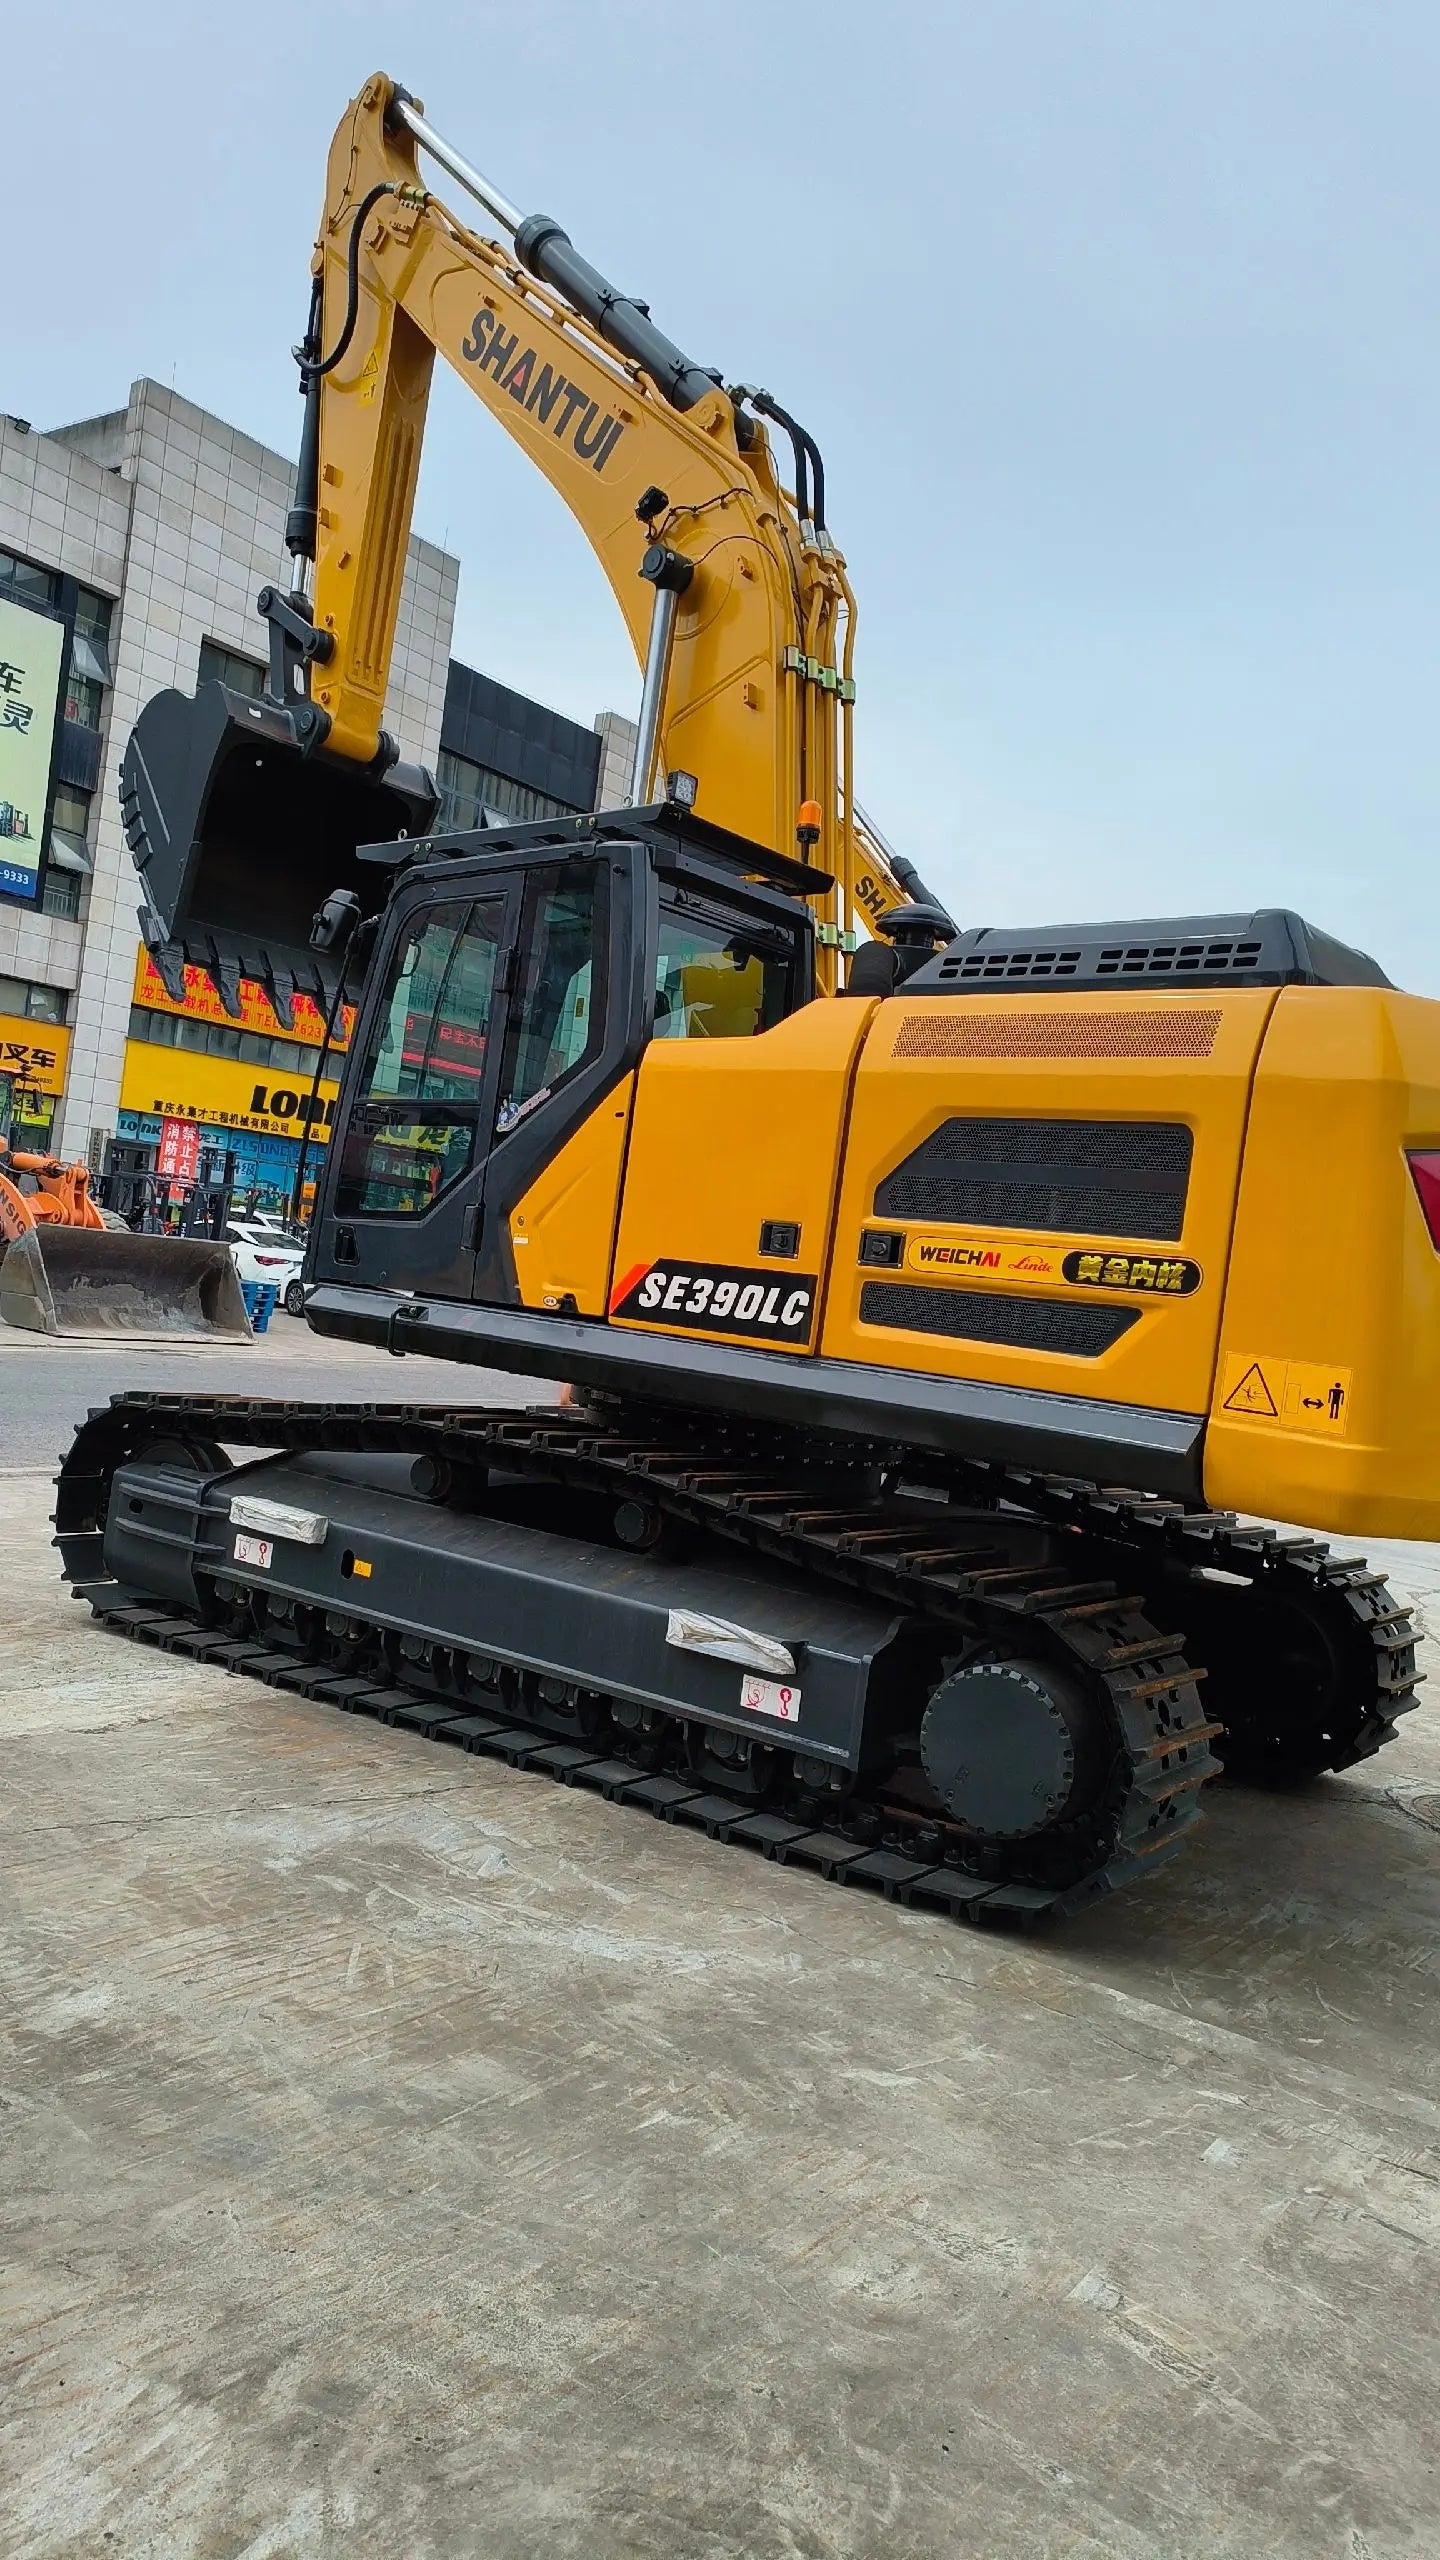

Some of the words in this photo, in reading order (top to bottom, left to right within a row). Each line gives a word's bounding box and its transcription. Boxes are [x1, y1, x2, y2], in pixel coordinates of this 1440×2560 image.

[462, 308, 625, 473] SHANTUI
[855, 875, 888, 922] SH
[0, 1042, 57, 1069] 叉车
[152, 1099, 290, 1134] 重庆永集才工程机械有限公司
[920, 1245, 1001, 1268] WEICHAI
[1007, 1255, 1055, 1273] Linde
[638, 1271, 811, 1327] SE390LC
